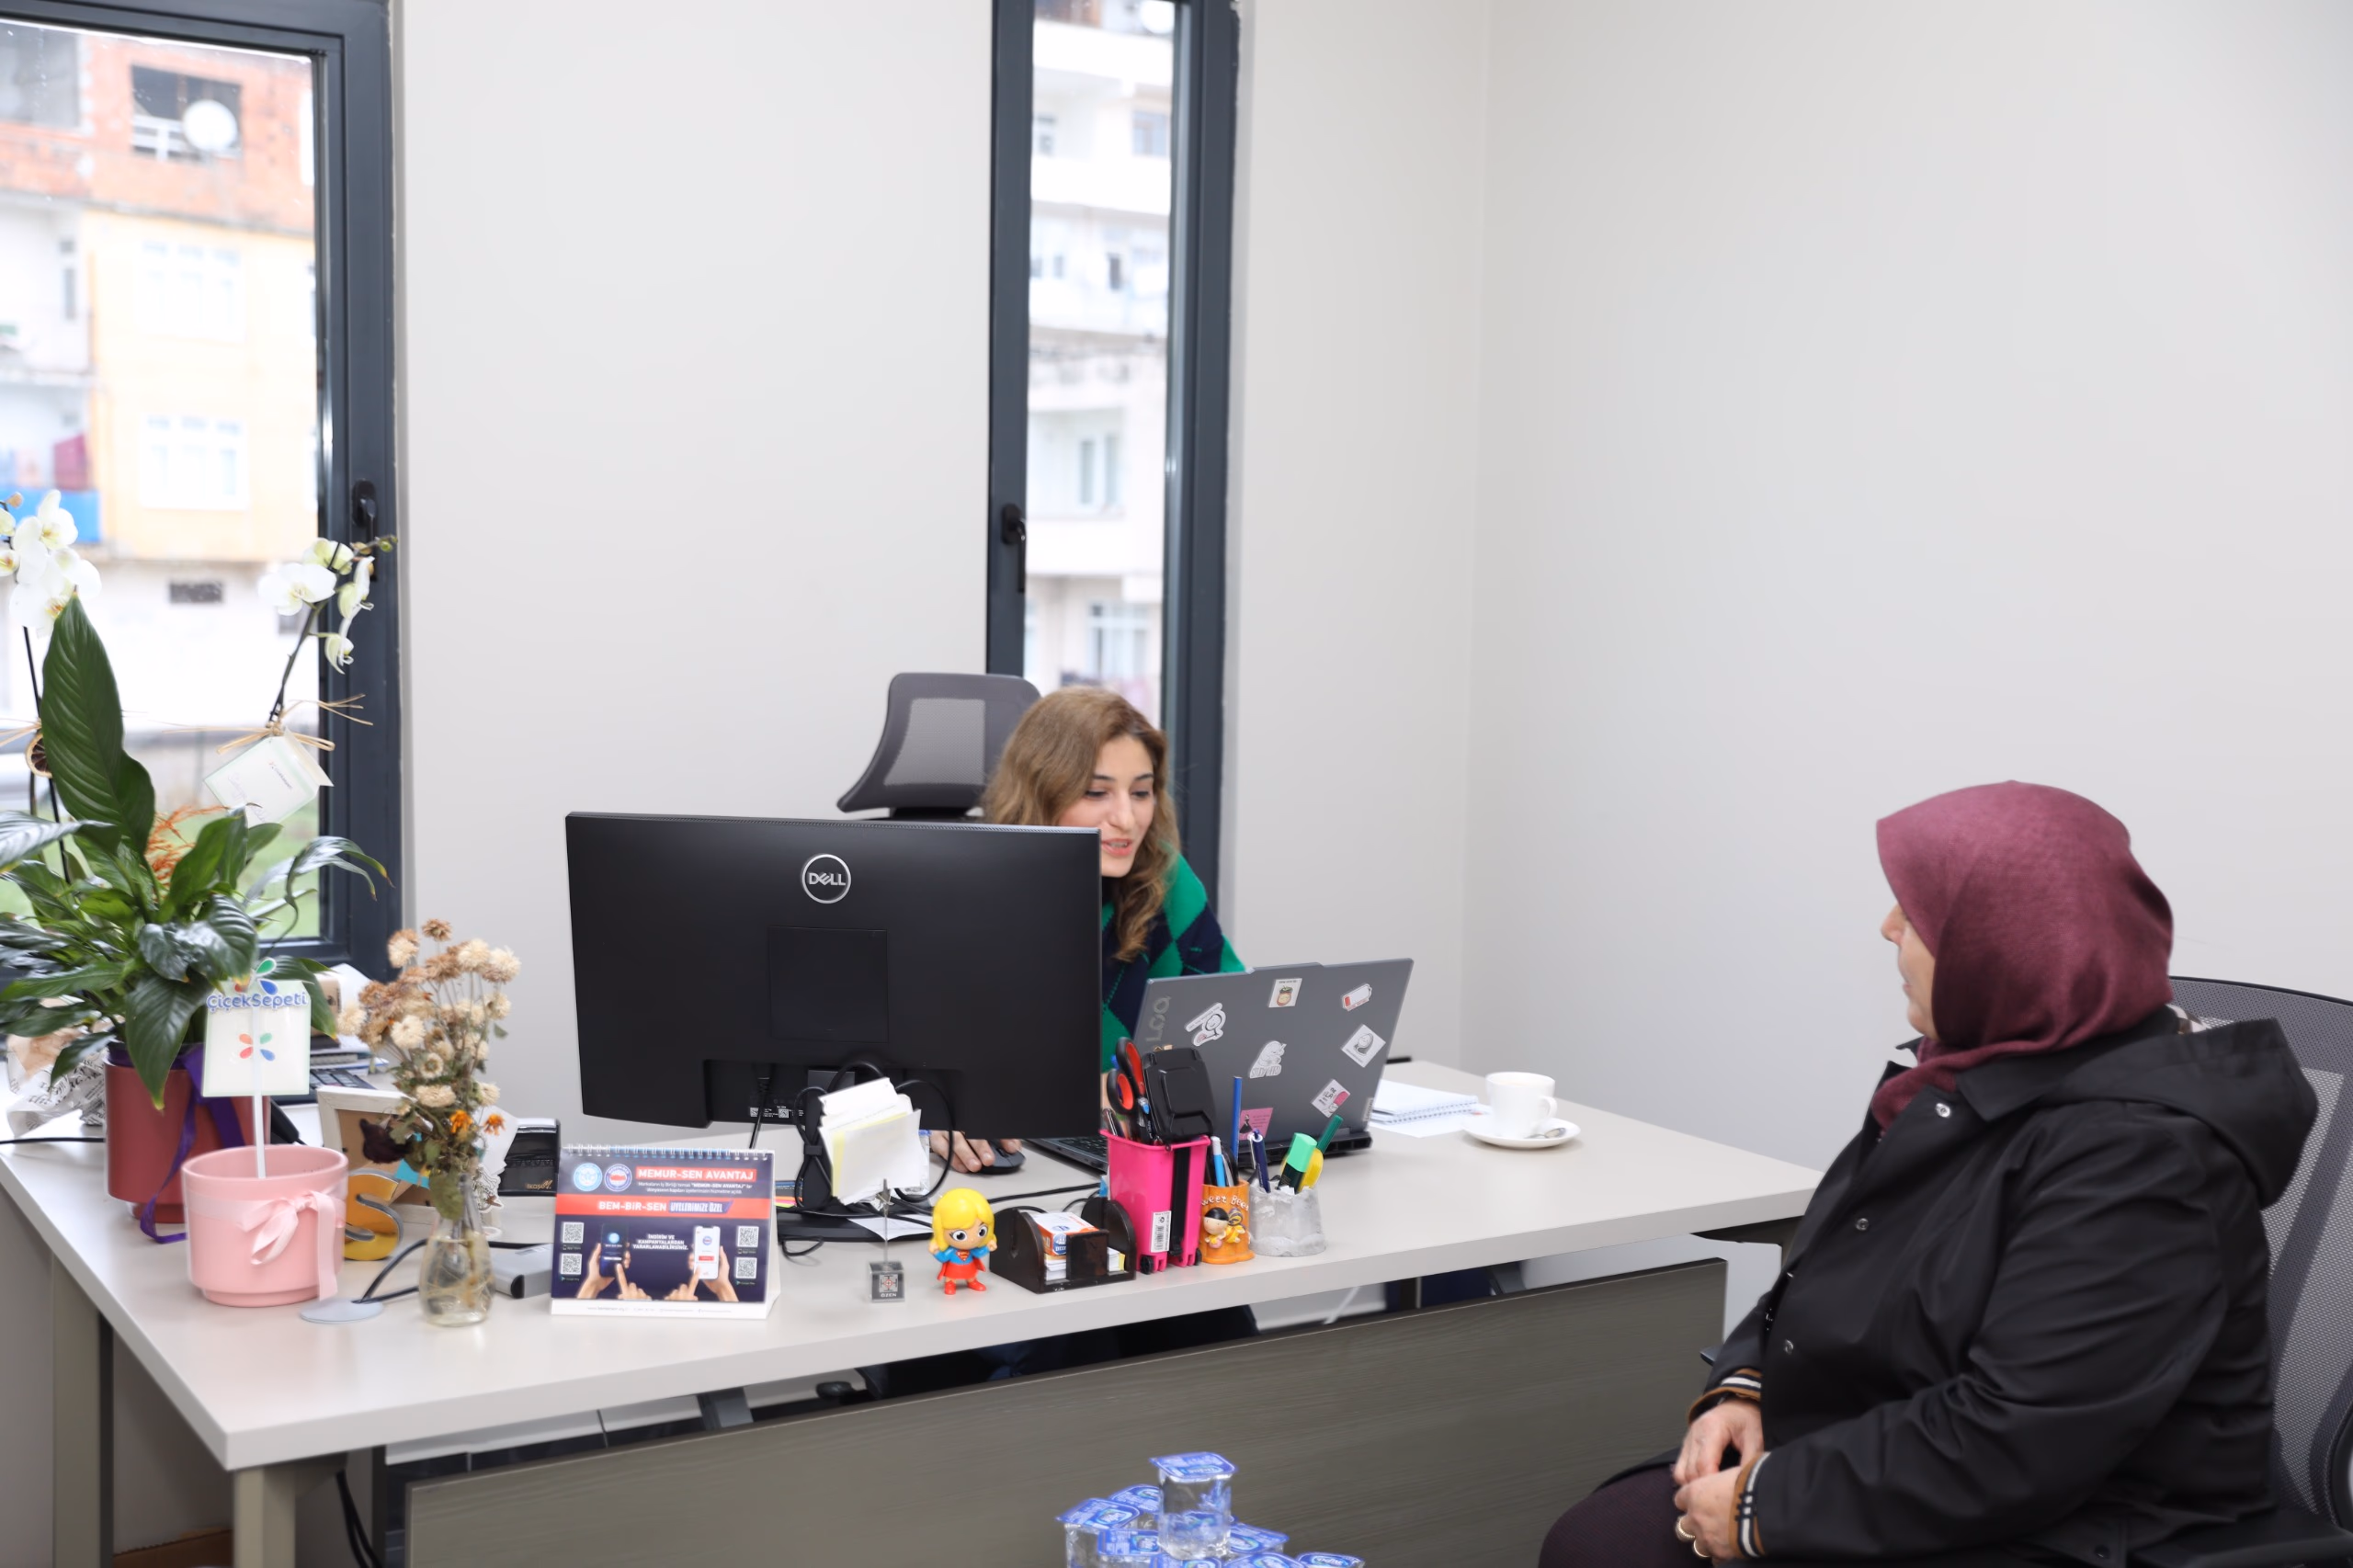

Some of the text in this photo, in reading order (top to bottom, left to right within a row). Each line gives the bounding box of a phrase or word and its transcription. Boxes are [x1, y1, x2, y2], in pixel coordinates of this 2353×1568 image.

[809, 872, 846, 886] DELL
[207, 992, 308, 1011] ÇiçekSepeti
[638, 1168, 703, 1179] MEMUR-SEN
[705, 1170, 753, 1180] AVANTAJ
[1201, 1196, 1226, 1205] weet
